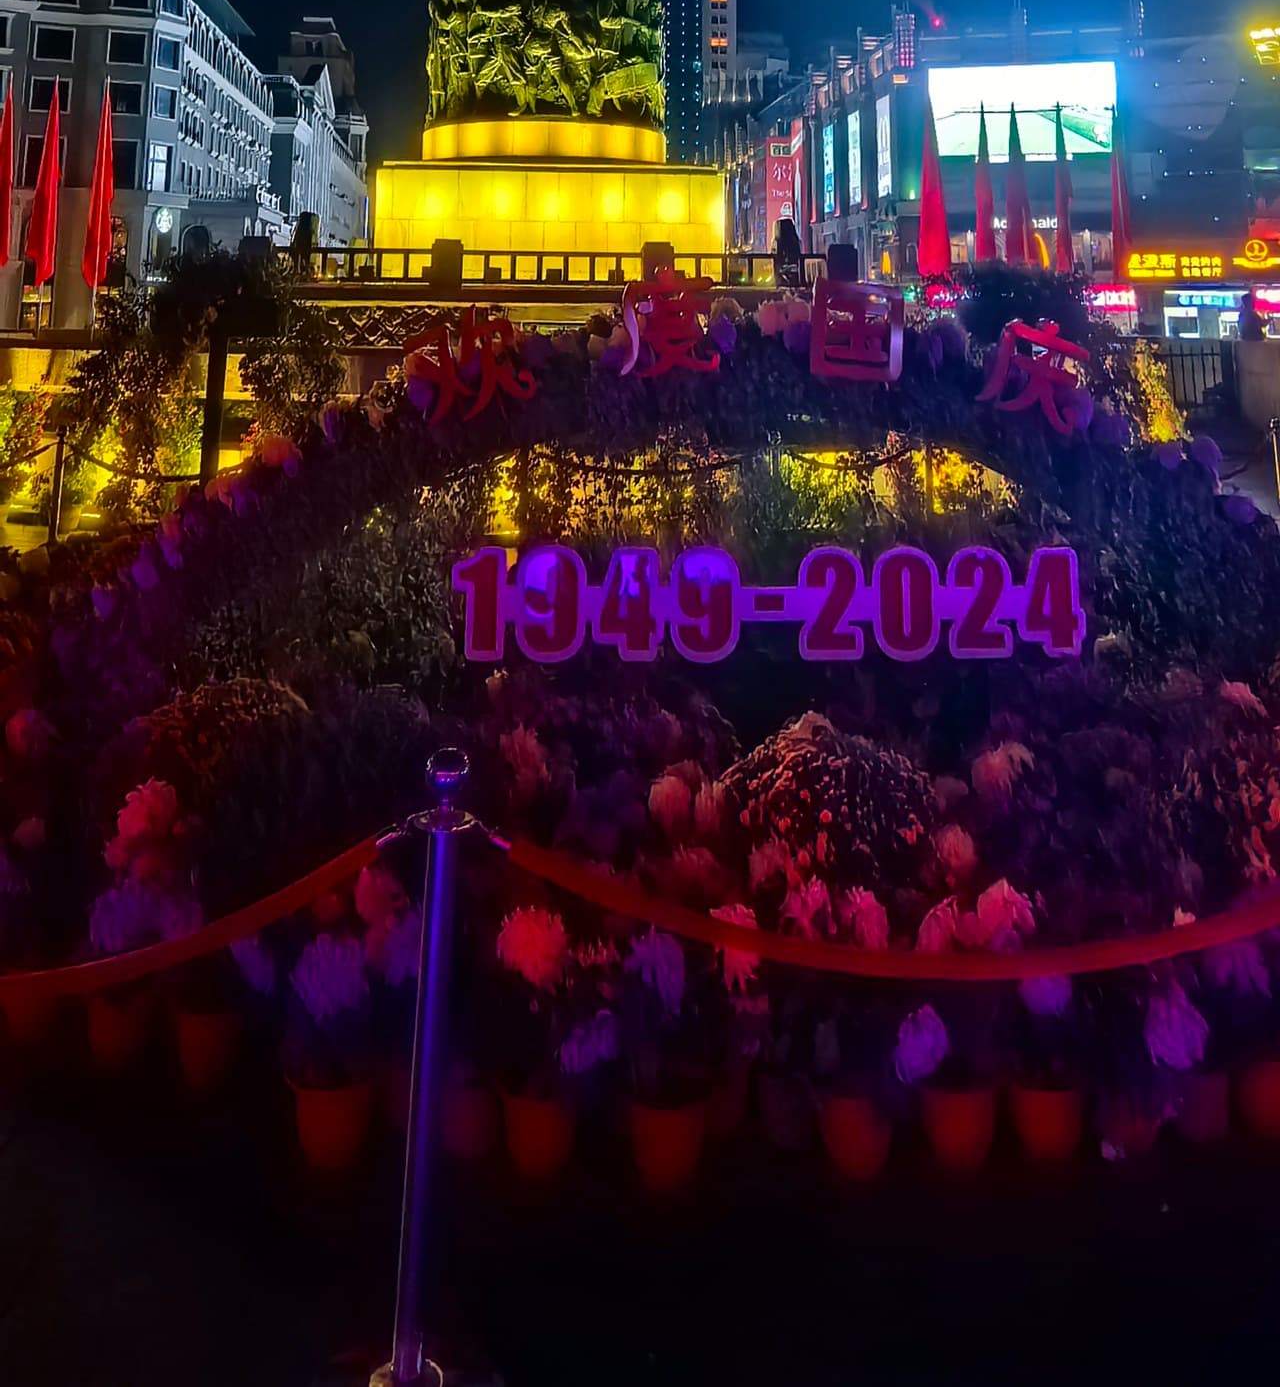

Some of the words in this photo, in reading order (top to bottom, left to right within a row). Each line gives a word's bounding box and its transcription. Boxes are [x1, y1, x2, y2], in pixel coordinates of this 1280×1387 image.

[402, 269, 1091, 436] 欢度国庆
[454, 546, 1086, 662] 1949-2024
